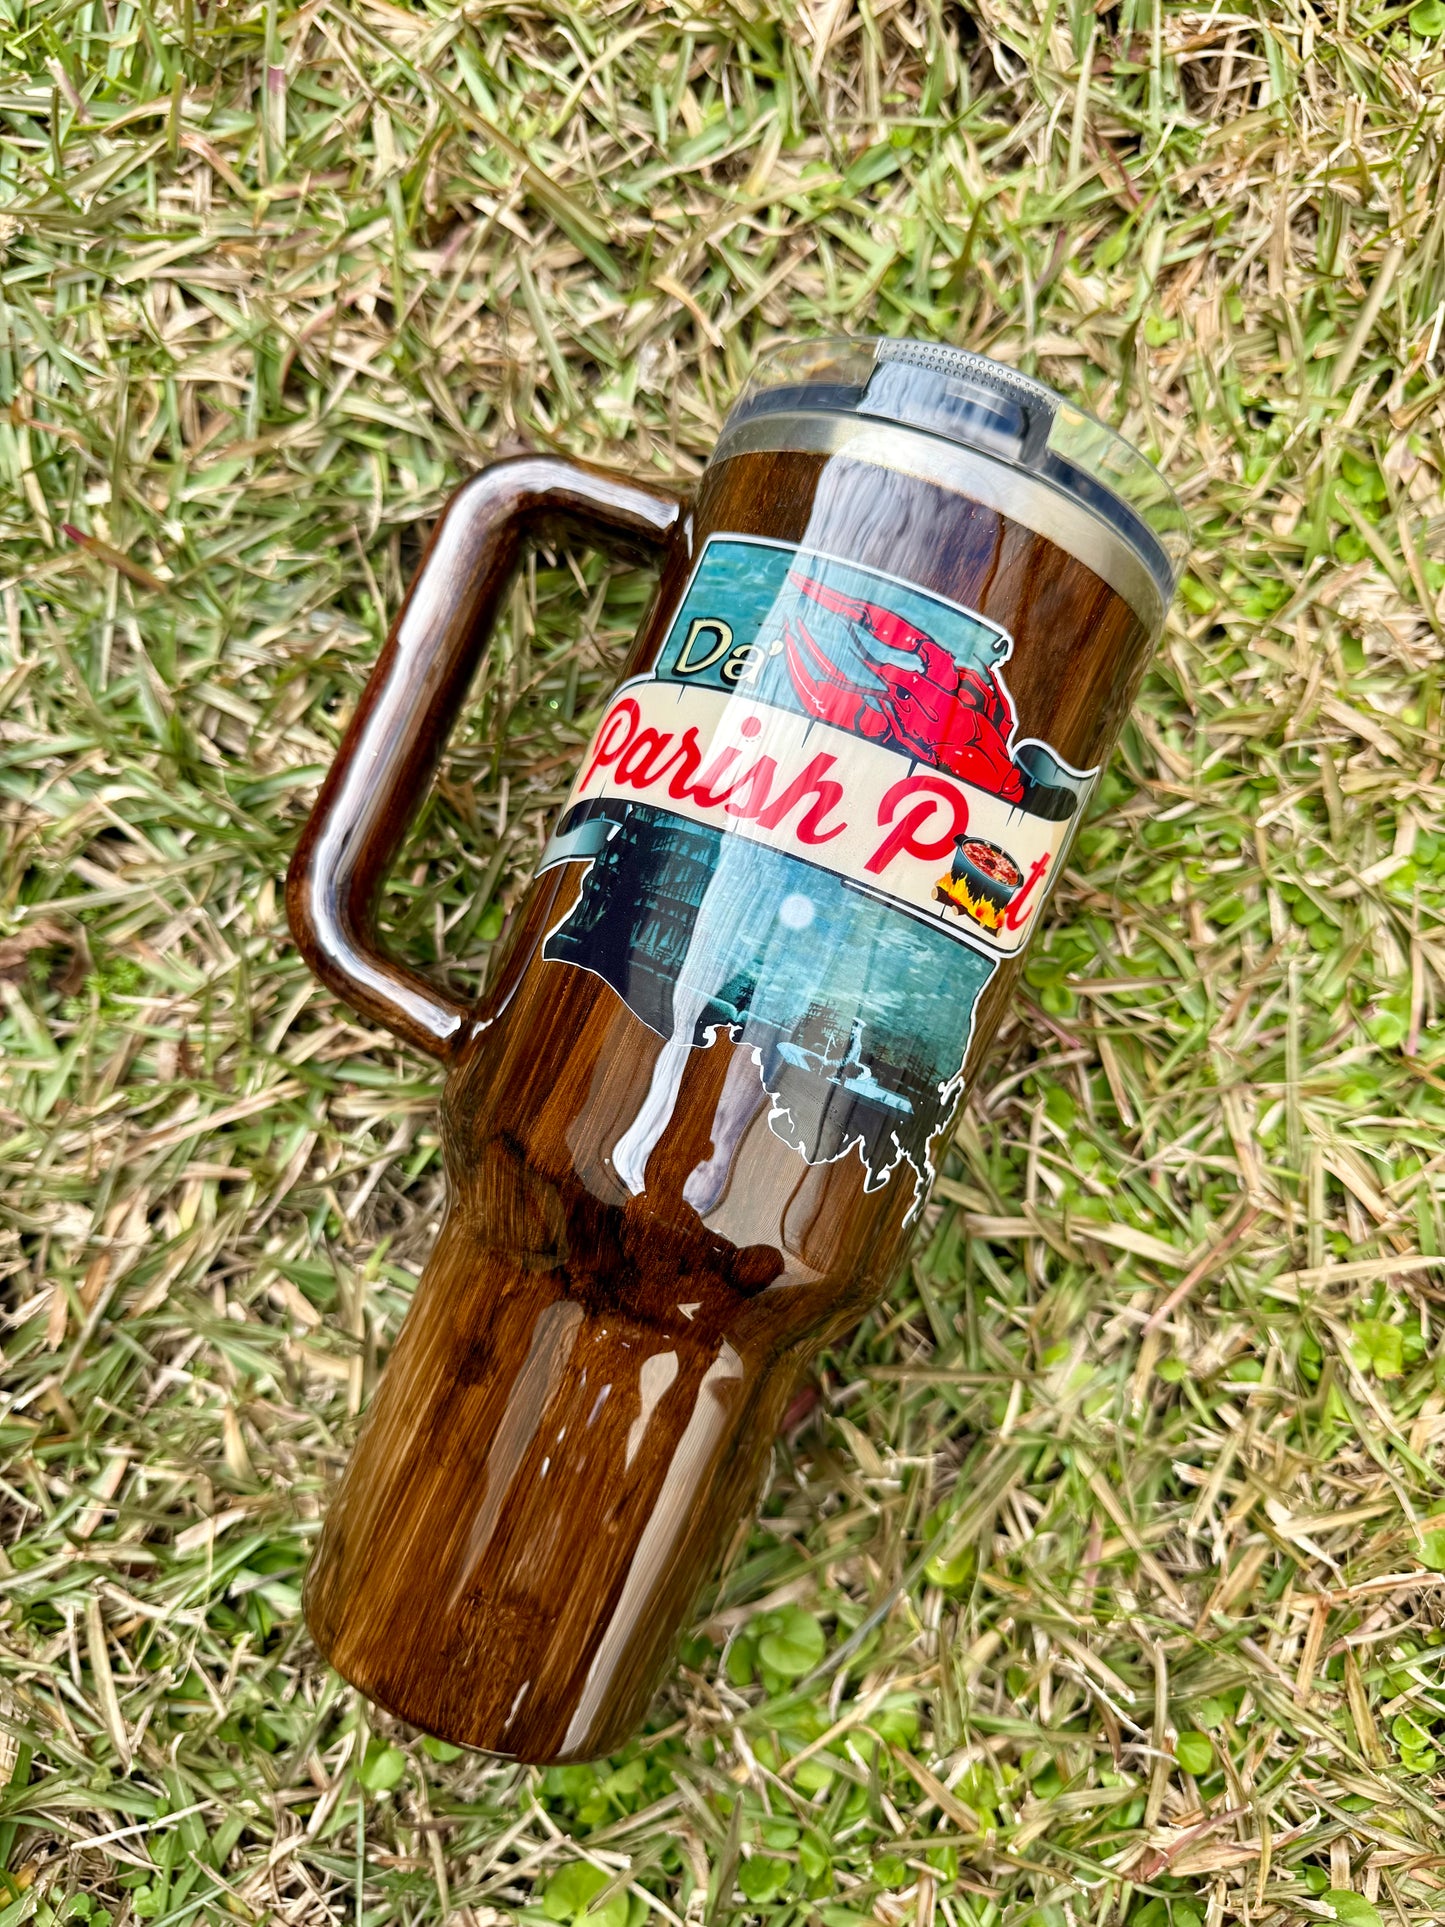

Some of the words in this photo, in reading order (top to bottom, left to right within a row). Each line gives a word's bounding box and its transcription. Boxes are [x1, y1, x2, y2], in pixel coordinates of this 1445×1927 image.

[672, 617, 784, 686] Da'
[579, 698, 848, 845] Parish
[864, 775, 1051, 932] Pt
